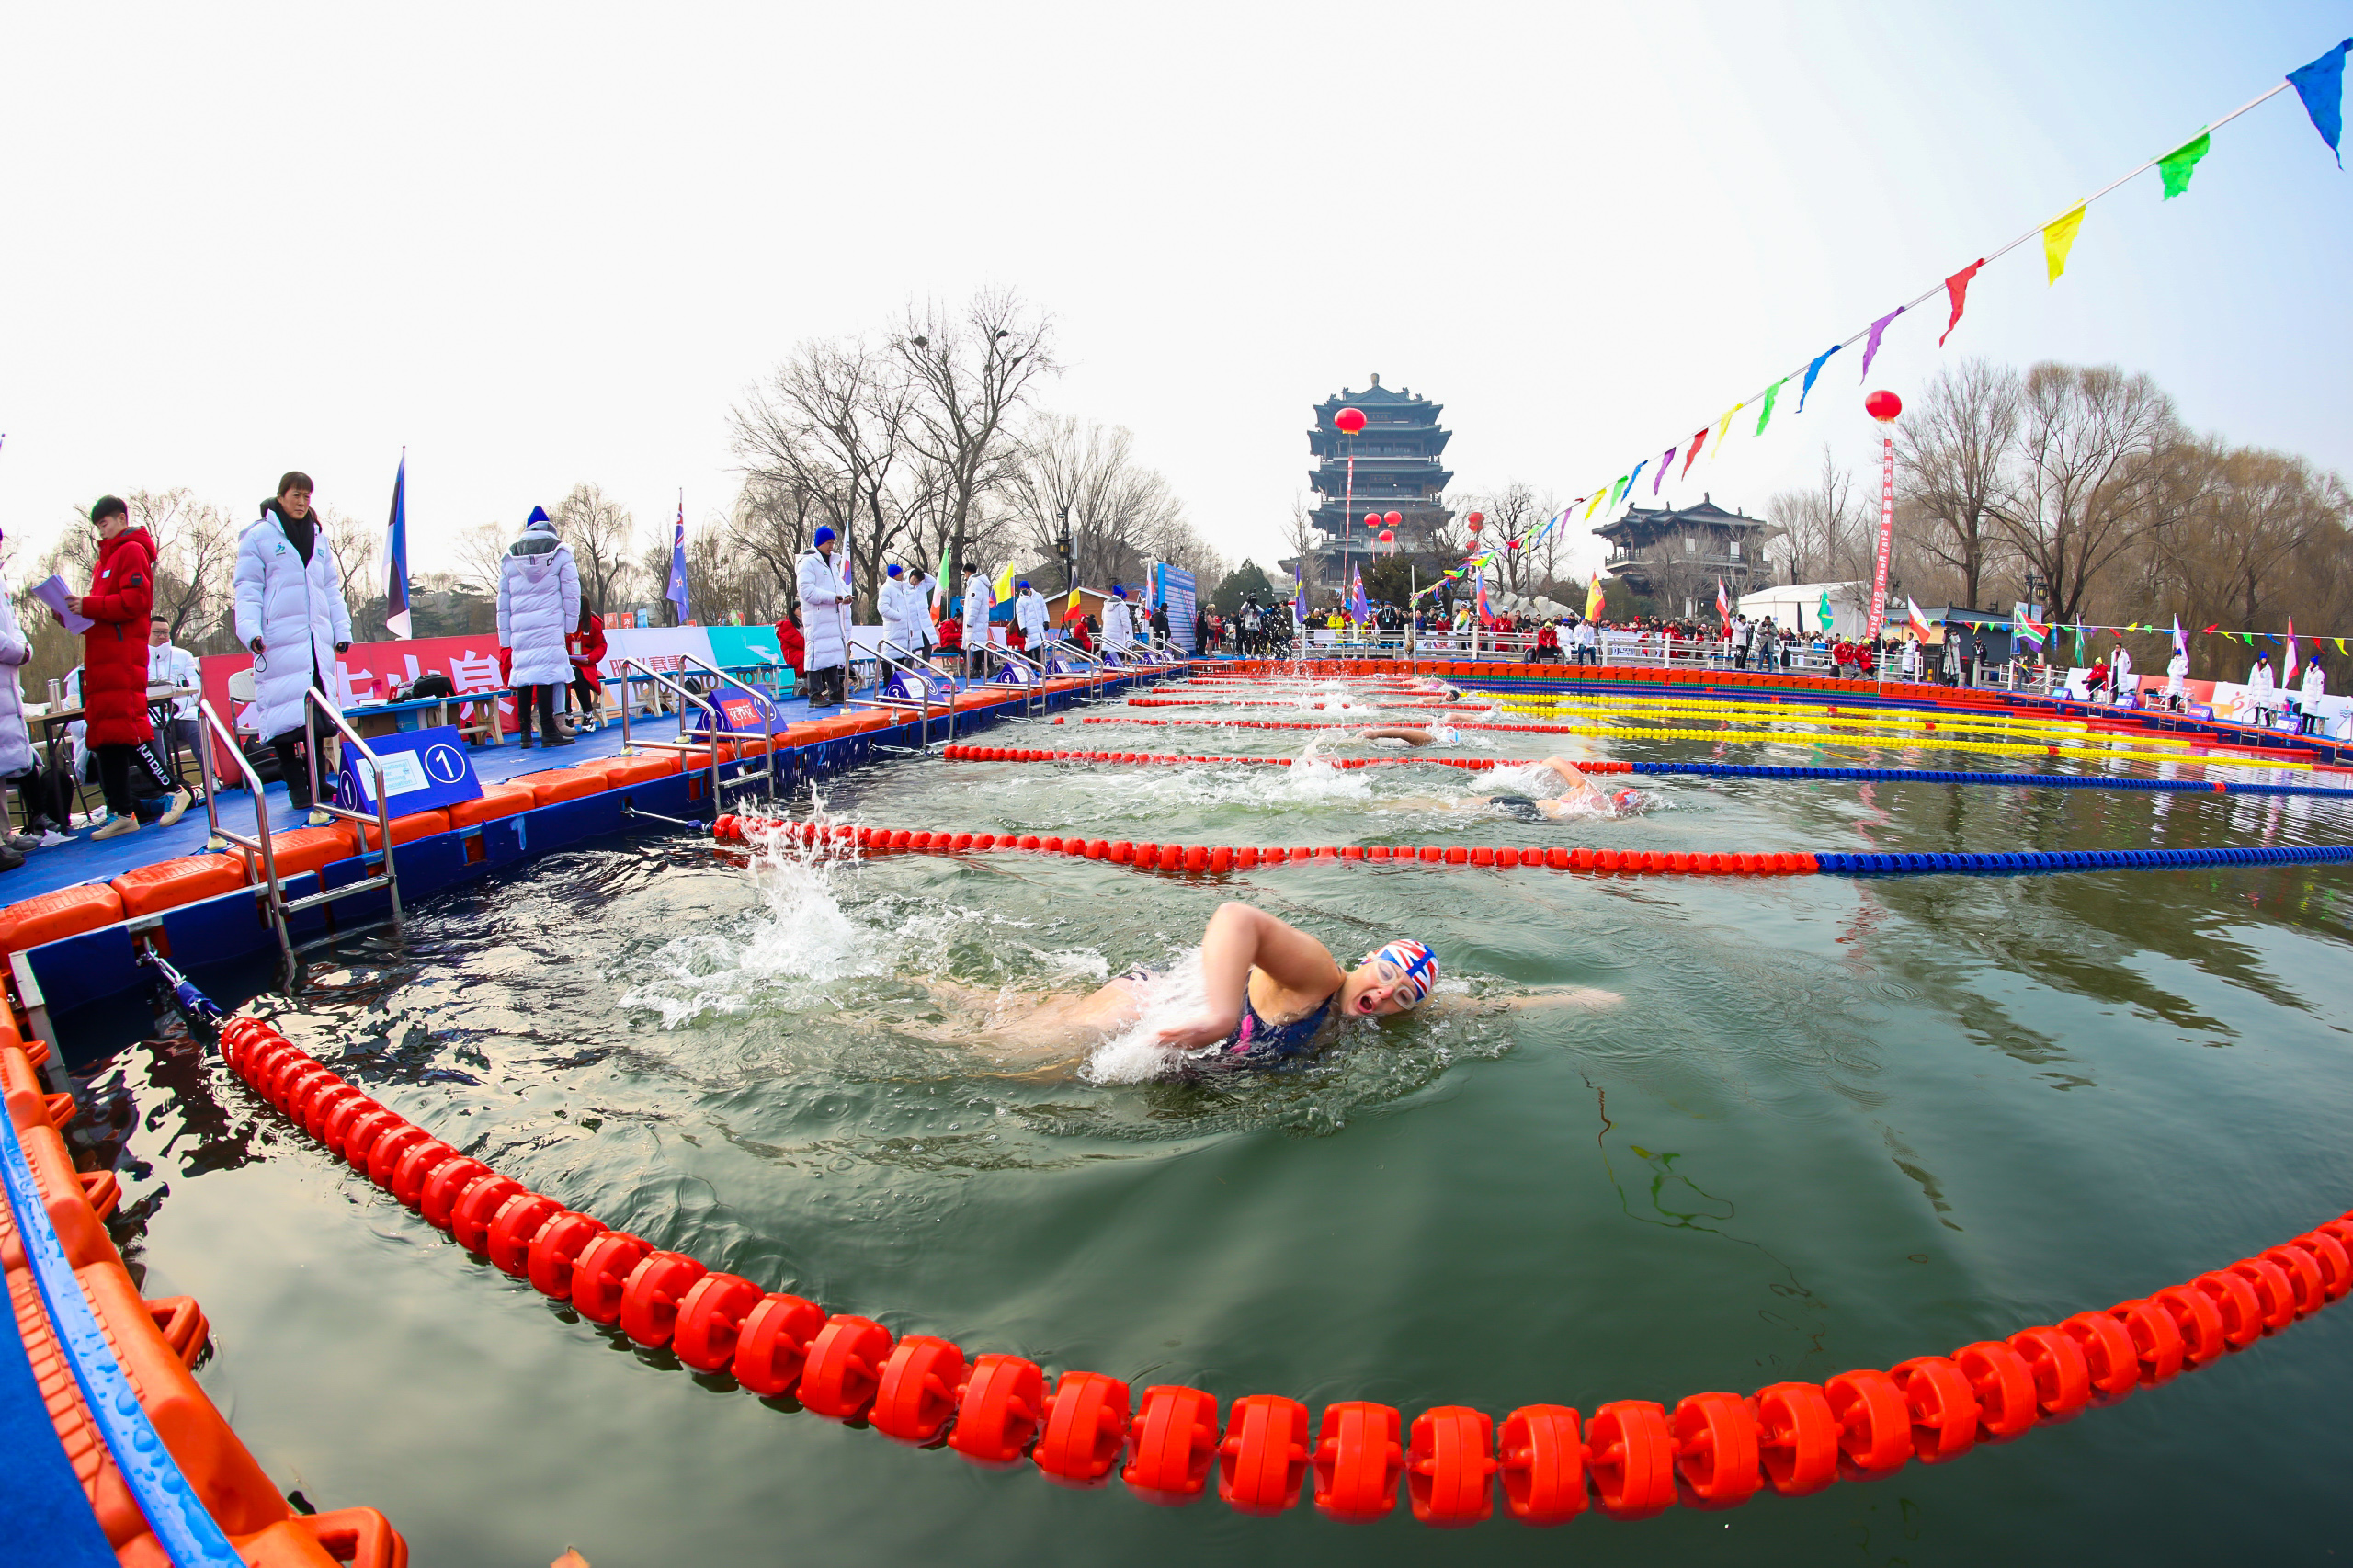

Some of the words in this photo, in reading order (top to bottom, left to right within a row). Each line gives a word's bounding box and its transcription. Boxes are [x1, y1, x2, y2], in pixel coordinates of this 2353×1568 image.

[1004, 675, 1011, 684] 4
[436, 750, 454, 778] 1
[345, 779, 352, 805] 1
[509, 815, 527, 851] 1
